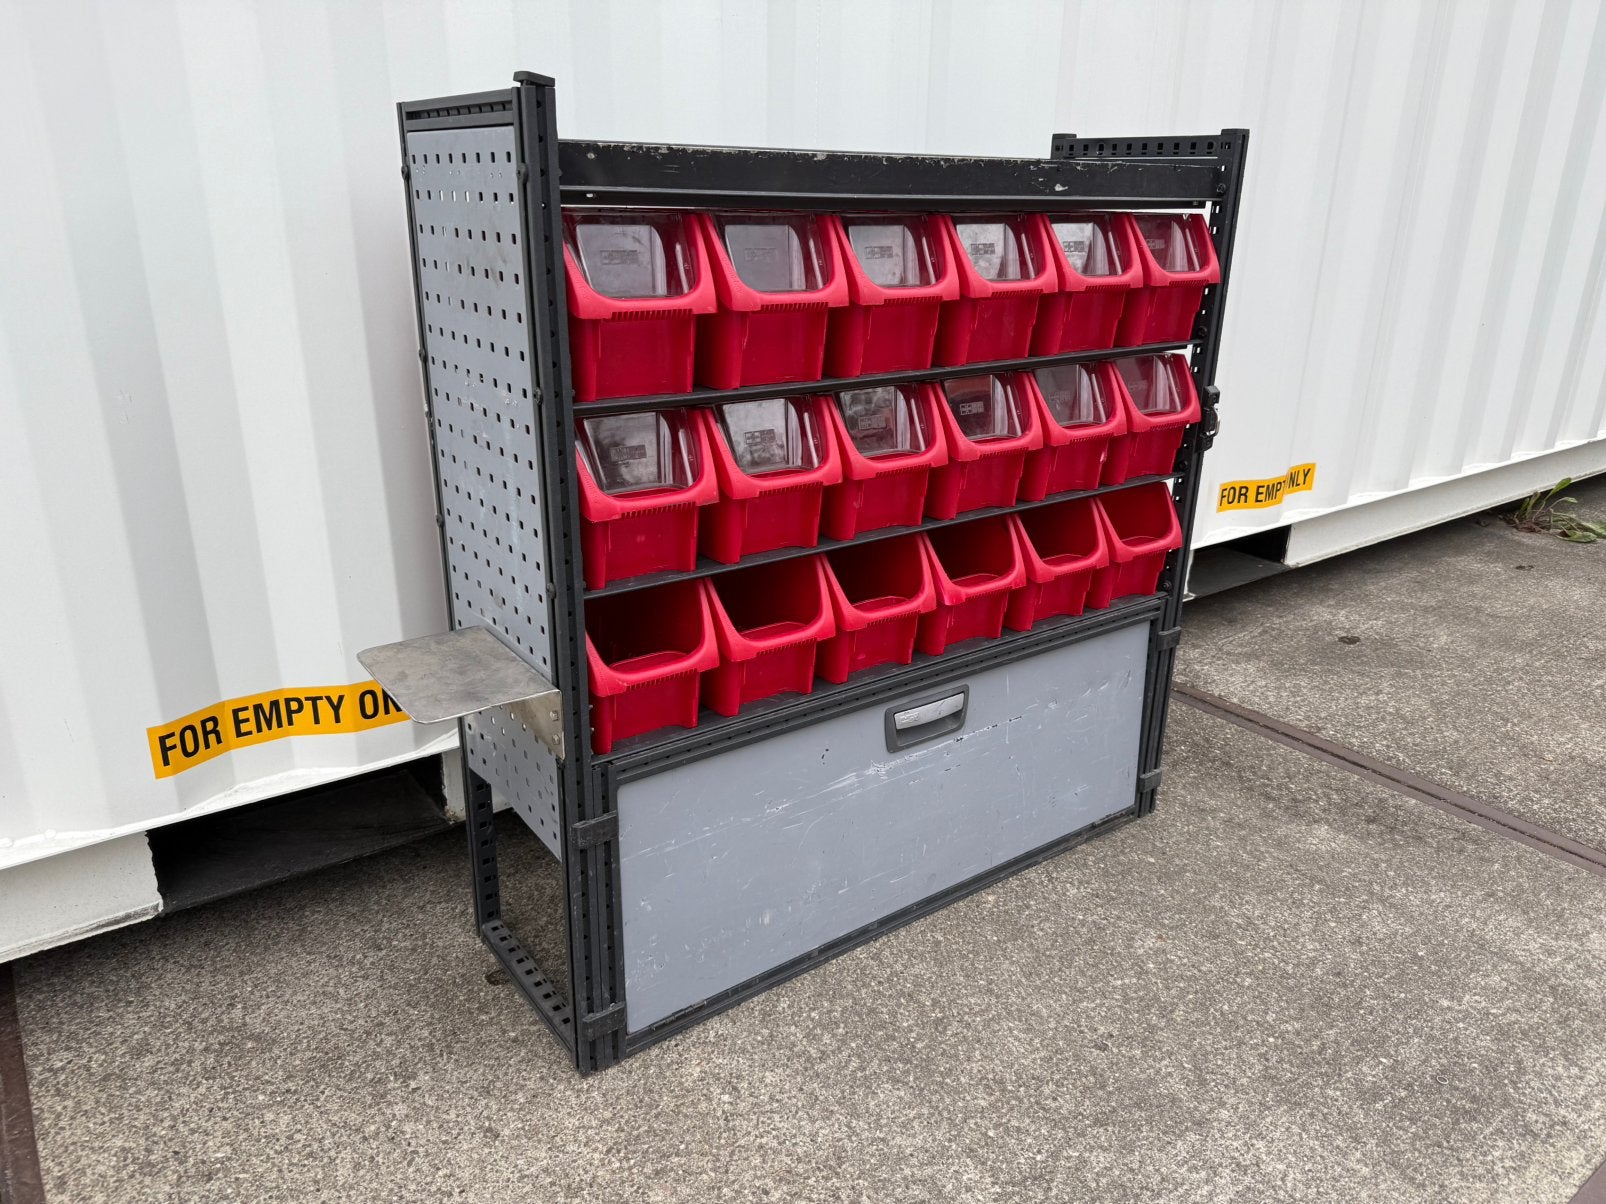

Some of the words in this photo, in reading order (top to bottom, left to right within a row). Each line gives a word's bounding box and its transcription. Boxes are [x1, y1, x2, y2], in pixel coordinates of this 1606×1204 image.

[1220, 486, 1249, 507] FOR
[158, 715, 223, 767] FOR
[231, 694, 345, 738] EMPTY
